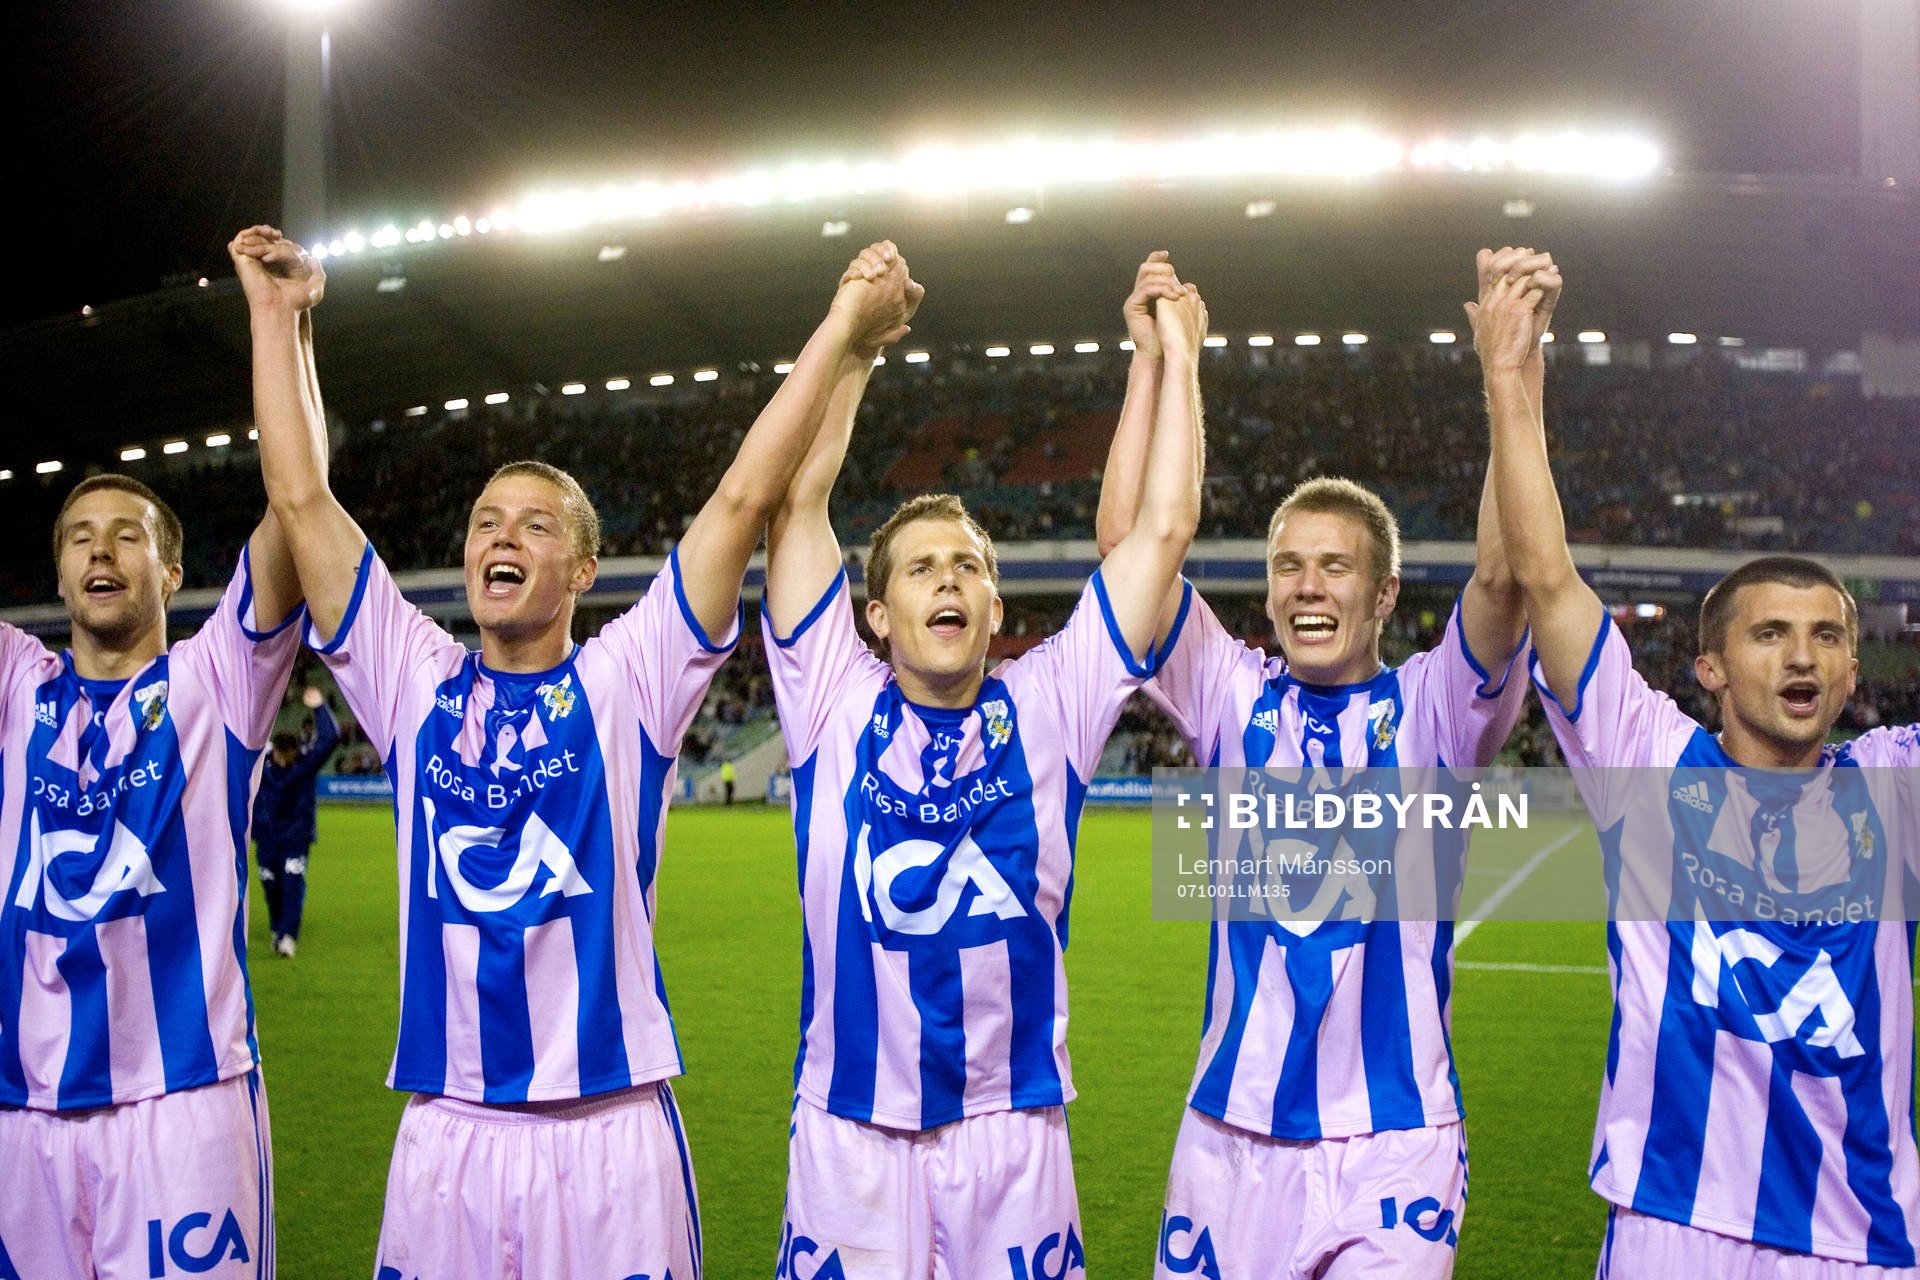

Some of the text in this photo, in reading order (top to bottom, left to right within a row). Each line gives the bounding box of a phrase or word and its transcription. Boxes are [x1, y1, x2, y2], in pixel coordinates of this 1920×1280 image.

[1251, 717, 1278, 735] adida
[33, 776, 70, 809] osa
[425, 754, 475, 803] Rosa
[860, 772, 1013, 823] Rsa Bandet
[1672, 789, 1714, 814] adidas
[14, 807, 167, 922] ICA
[422, 796, 594, 912] ICA
[854, 820, 1028, 935] ICA
[1247, 822, 1377, 937] ICA
[1682, 852, 1875, 928] Rosa Bandet
[1691, 897, 1866, 1059] ICA
[147, 1207, 250, 1279] ICA
[1007, 1222, 1086, 1280] ICA
[1160, 1208, 1221, 1280] ICA
